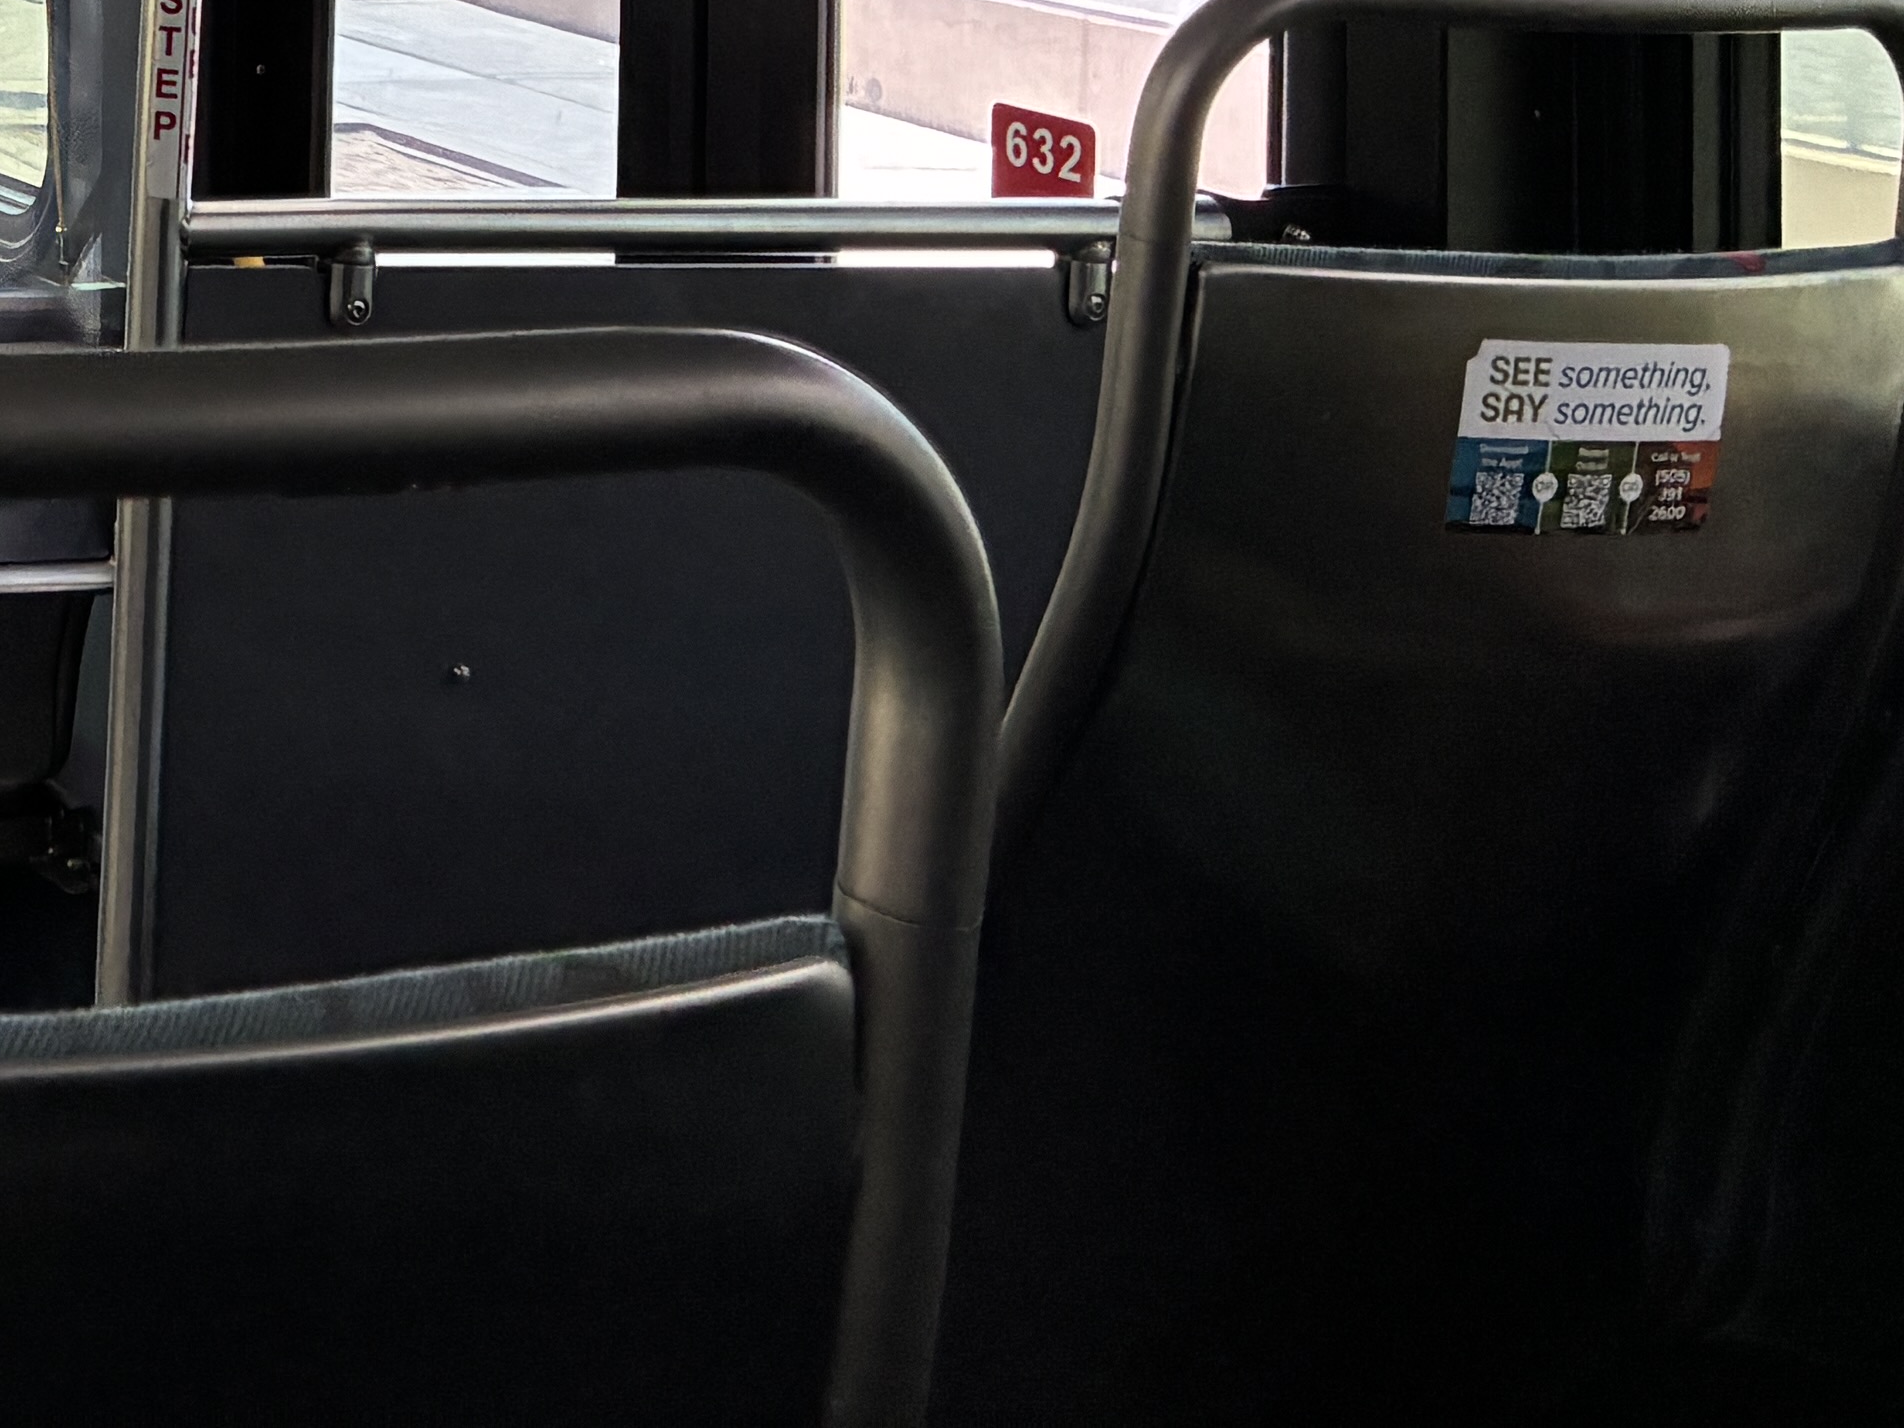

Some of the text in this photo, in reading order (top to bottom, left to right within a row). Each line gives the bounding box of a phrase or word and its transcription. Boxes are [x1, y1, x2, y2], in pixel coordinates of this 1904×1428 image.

[1006, 121, 1082, 183] 632
[1489, 356, 1712, 396] SEE something.
[1480, 392, 1706, 432] SAY something.
